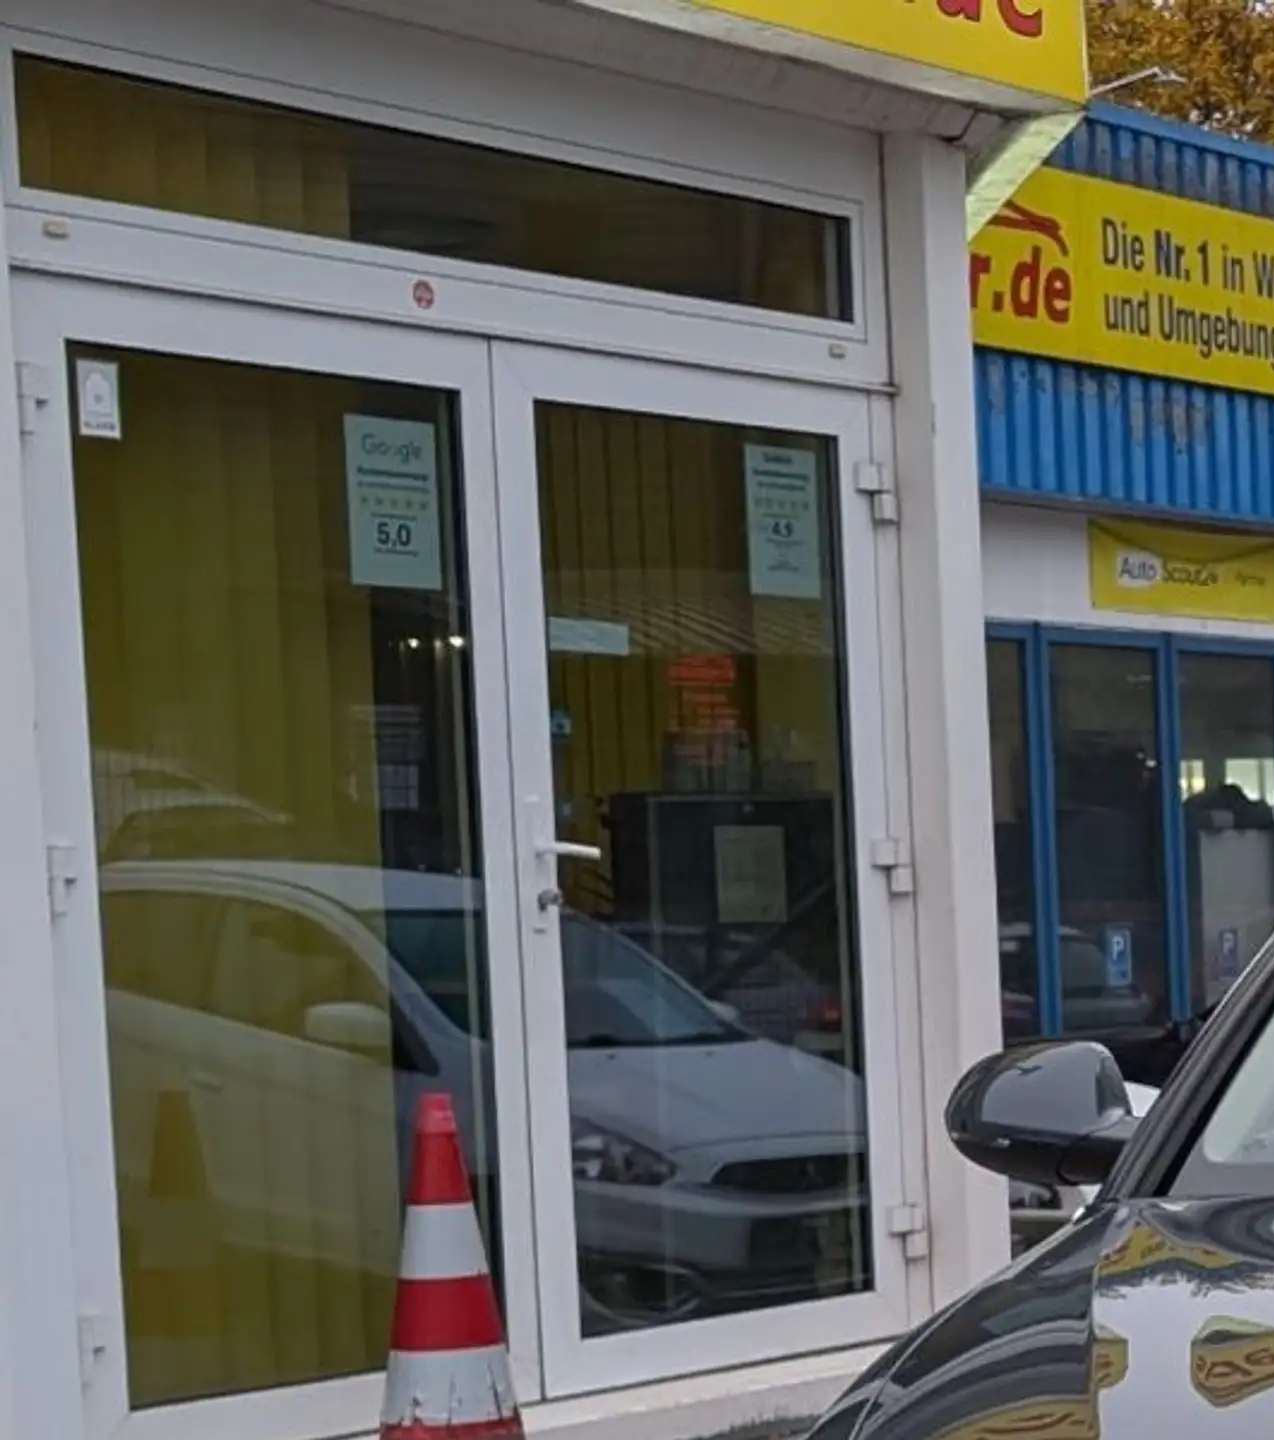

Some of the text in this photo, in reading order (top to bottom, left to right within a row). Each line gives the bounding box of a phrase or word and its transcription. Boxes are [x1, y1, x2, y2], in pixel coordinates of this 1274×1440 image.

[1101, 217, 1145, 273] Die
[1154, 229, 1191, 283] Nr.
[1198, 240, 1210, 287] 1
[1221, 244, 1246, 294] in
[1105, 290, 1151, 337] und
[360, 431, 423, 465] Google
[1118, 556, 1157, 580] Auto
